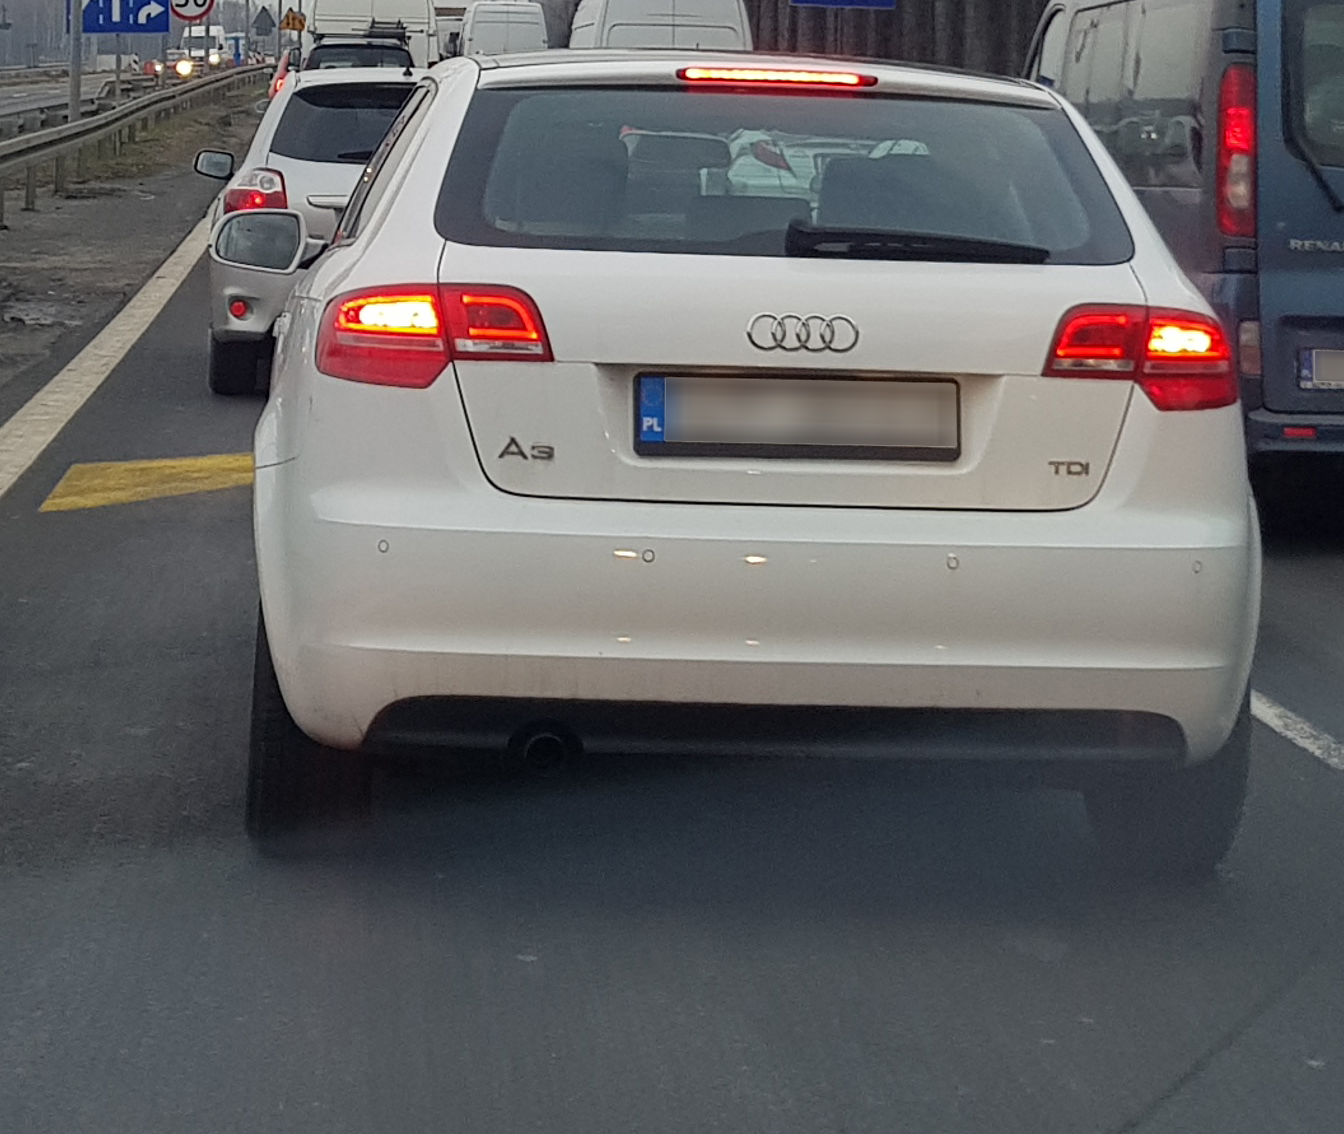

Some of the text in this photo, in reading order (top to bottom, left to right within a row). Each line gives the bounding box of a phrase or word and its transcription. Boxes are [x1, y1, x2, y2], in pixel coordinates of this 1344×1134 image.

[642, 416, 662, 432] PL
[497, 435, 555, 462] A3
[1047, 460, 1090, 477] TDI
